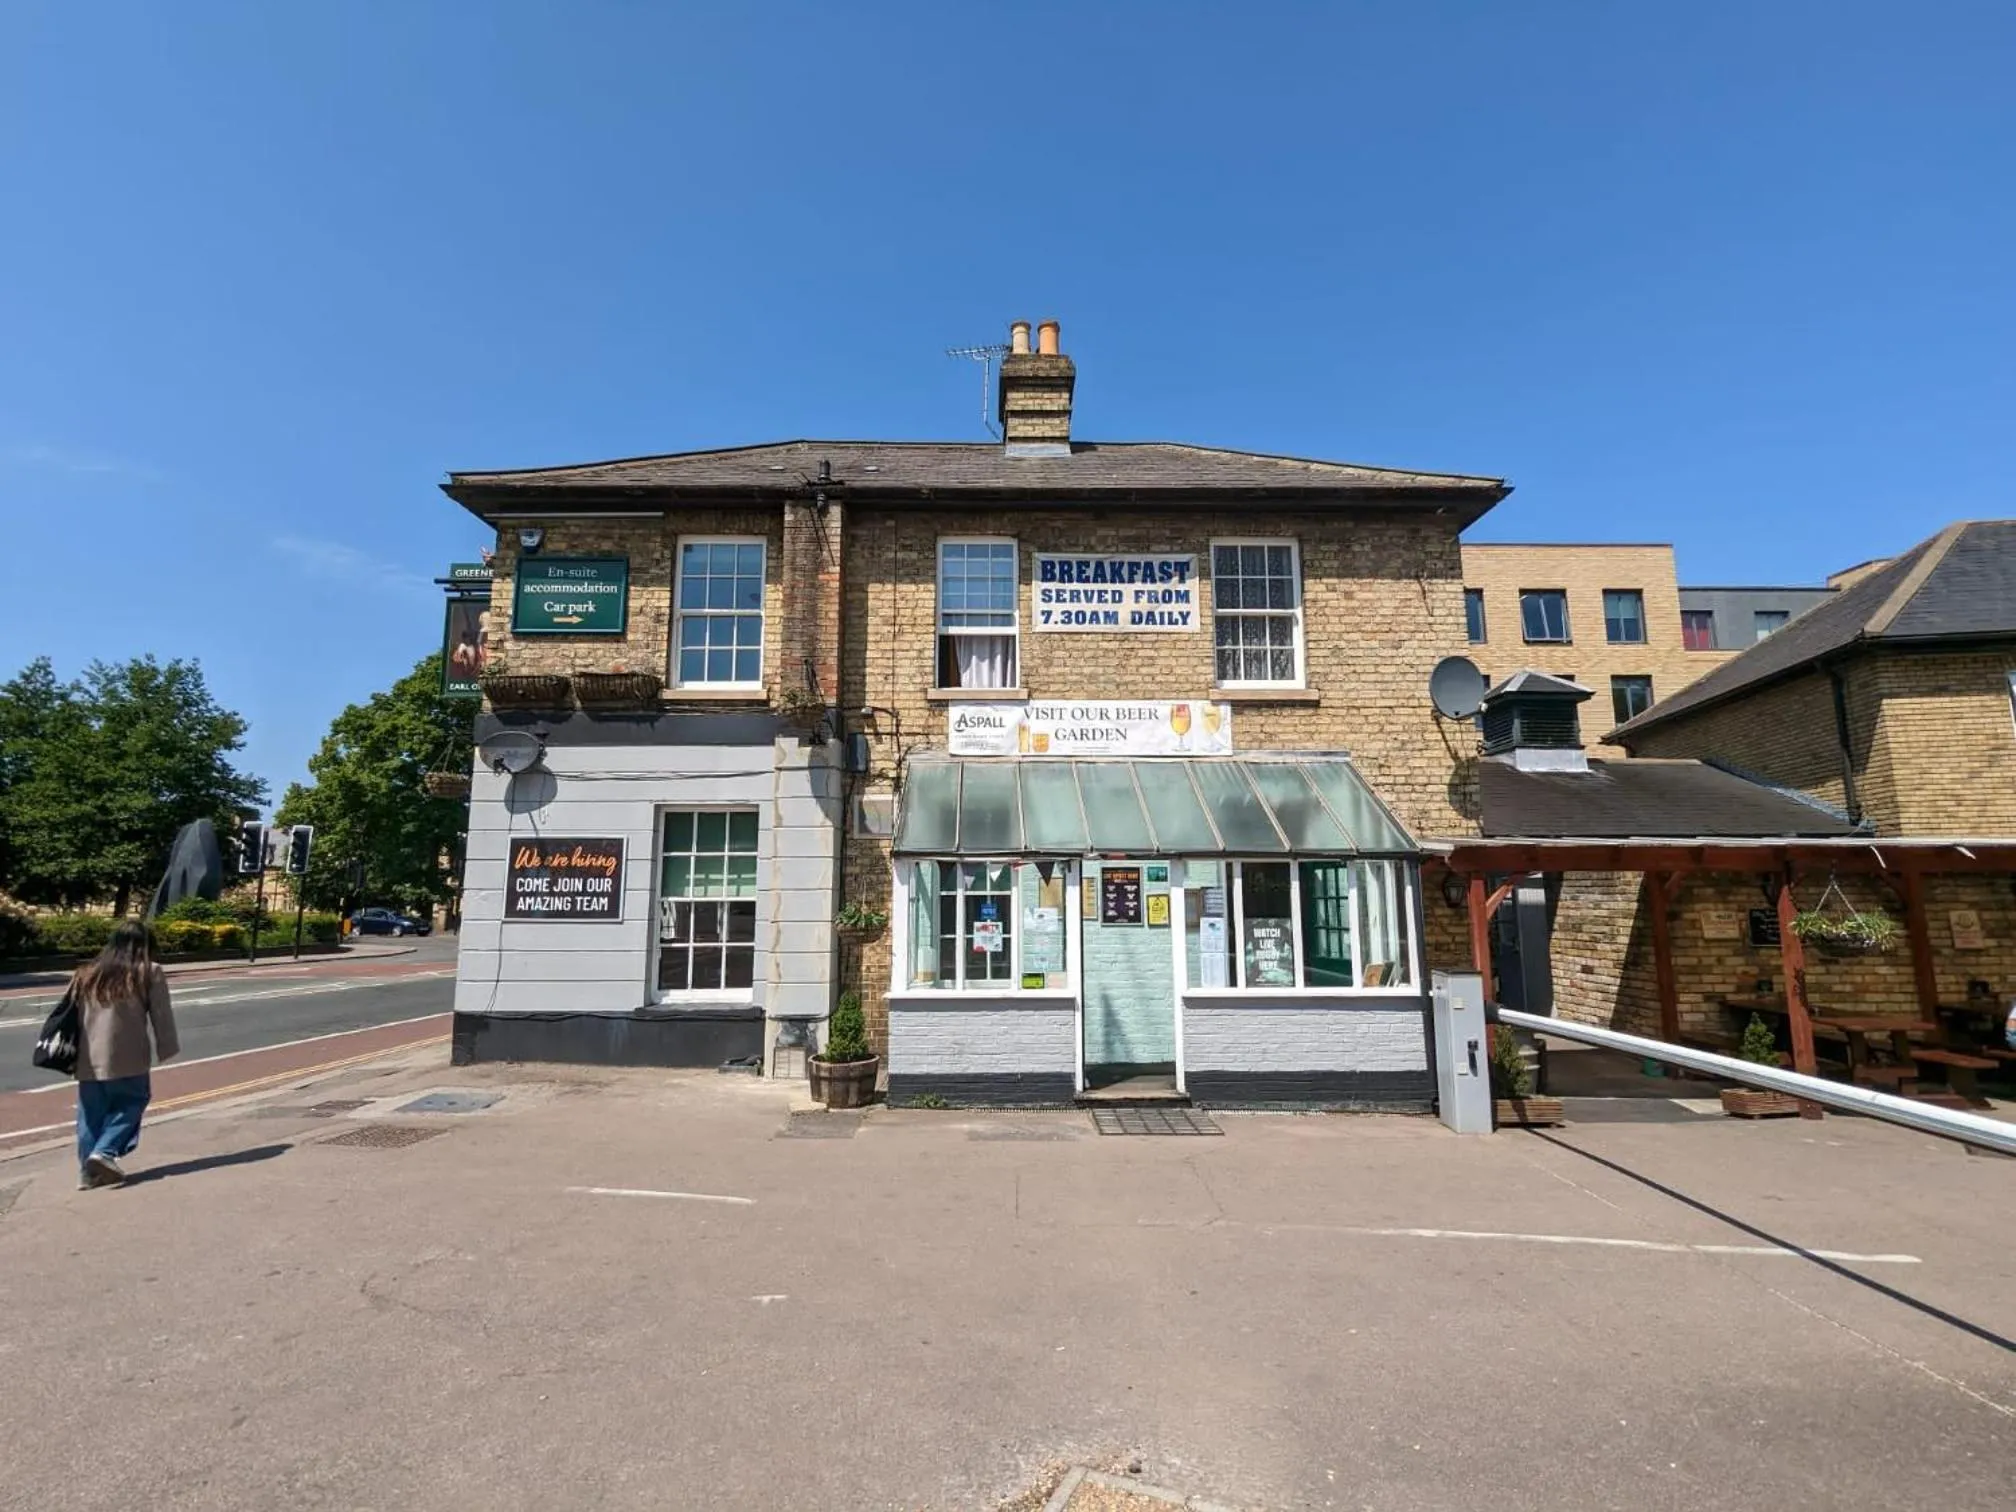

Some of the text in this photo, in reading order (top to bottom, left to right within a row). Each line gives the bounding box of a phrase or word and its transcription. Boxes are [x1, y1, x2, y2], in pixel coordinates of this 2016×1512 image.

[455, 569, 494, 577] GREENE
[548, 567, 598, 577] En-suite
[1040, 560, 1190, 584] BREAKFAST
[523, 582, 618, 593] accommodation
[1041, 589, 1191, 604] SERVED FROM
[544, 600, 596, 615] Car park
[1041, 610, 1191, 625] 7.30AM DAILY
[1023, 707, 1159, 720] VISIT OUR BEER
[1054, 727, 1128, 741] GARDEN
[514, 846, 617, 876] We are hiring
[516, 878, 612, 892] COME JOIN OUR
[516, 896, 608, 911] AMAZING TEAM
[1253, 927, 1281, 938] WATCH
